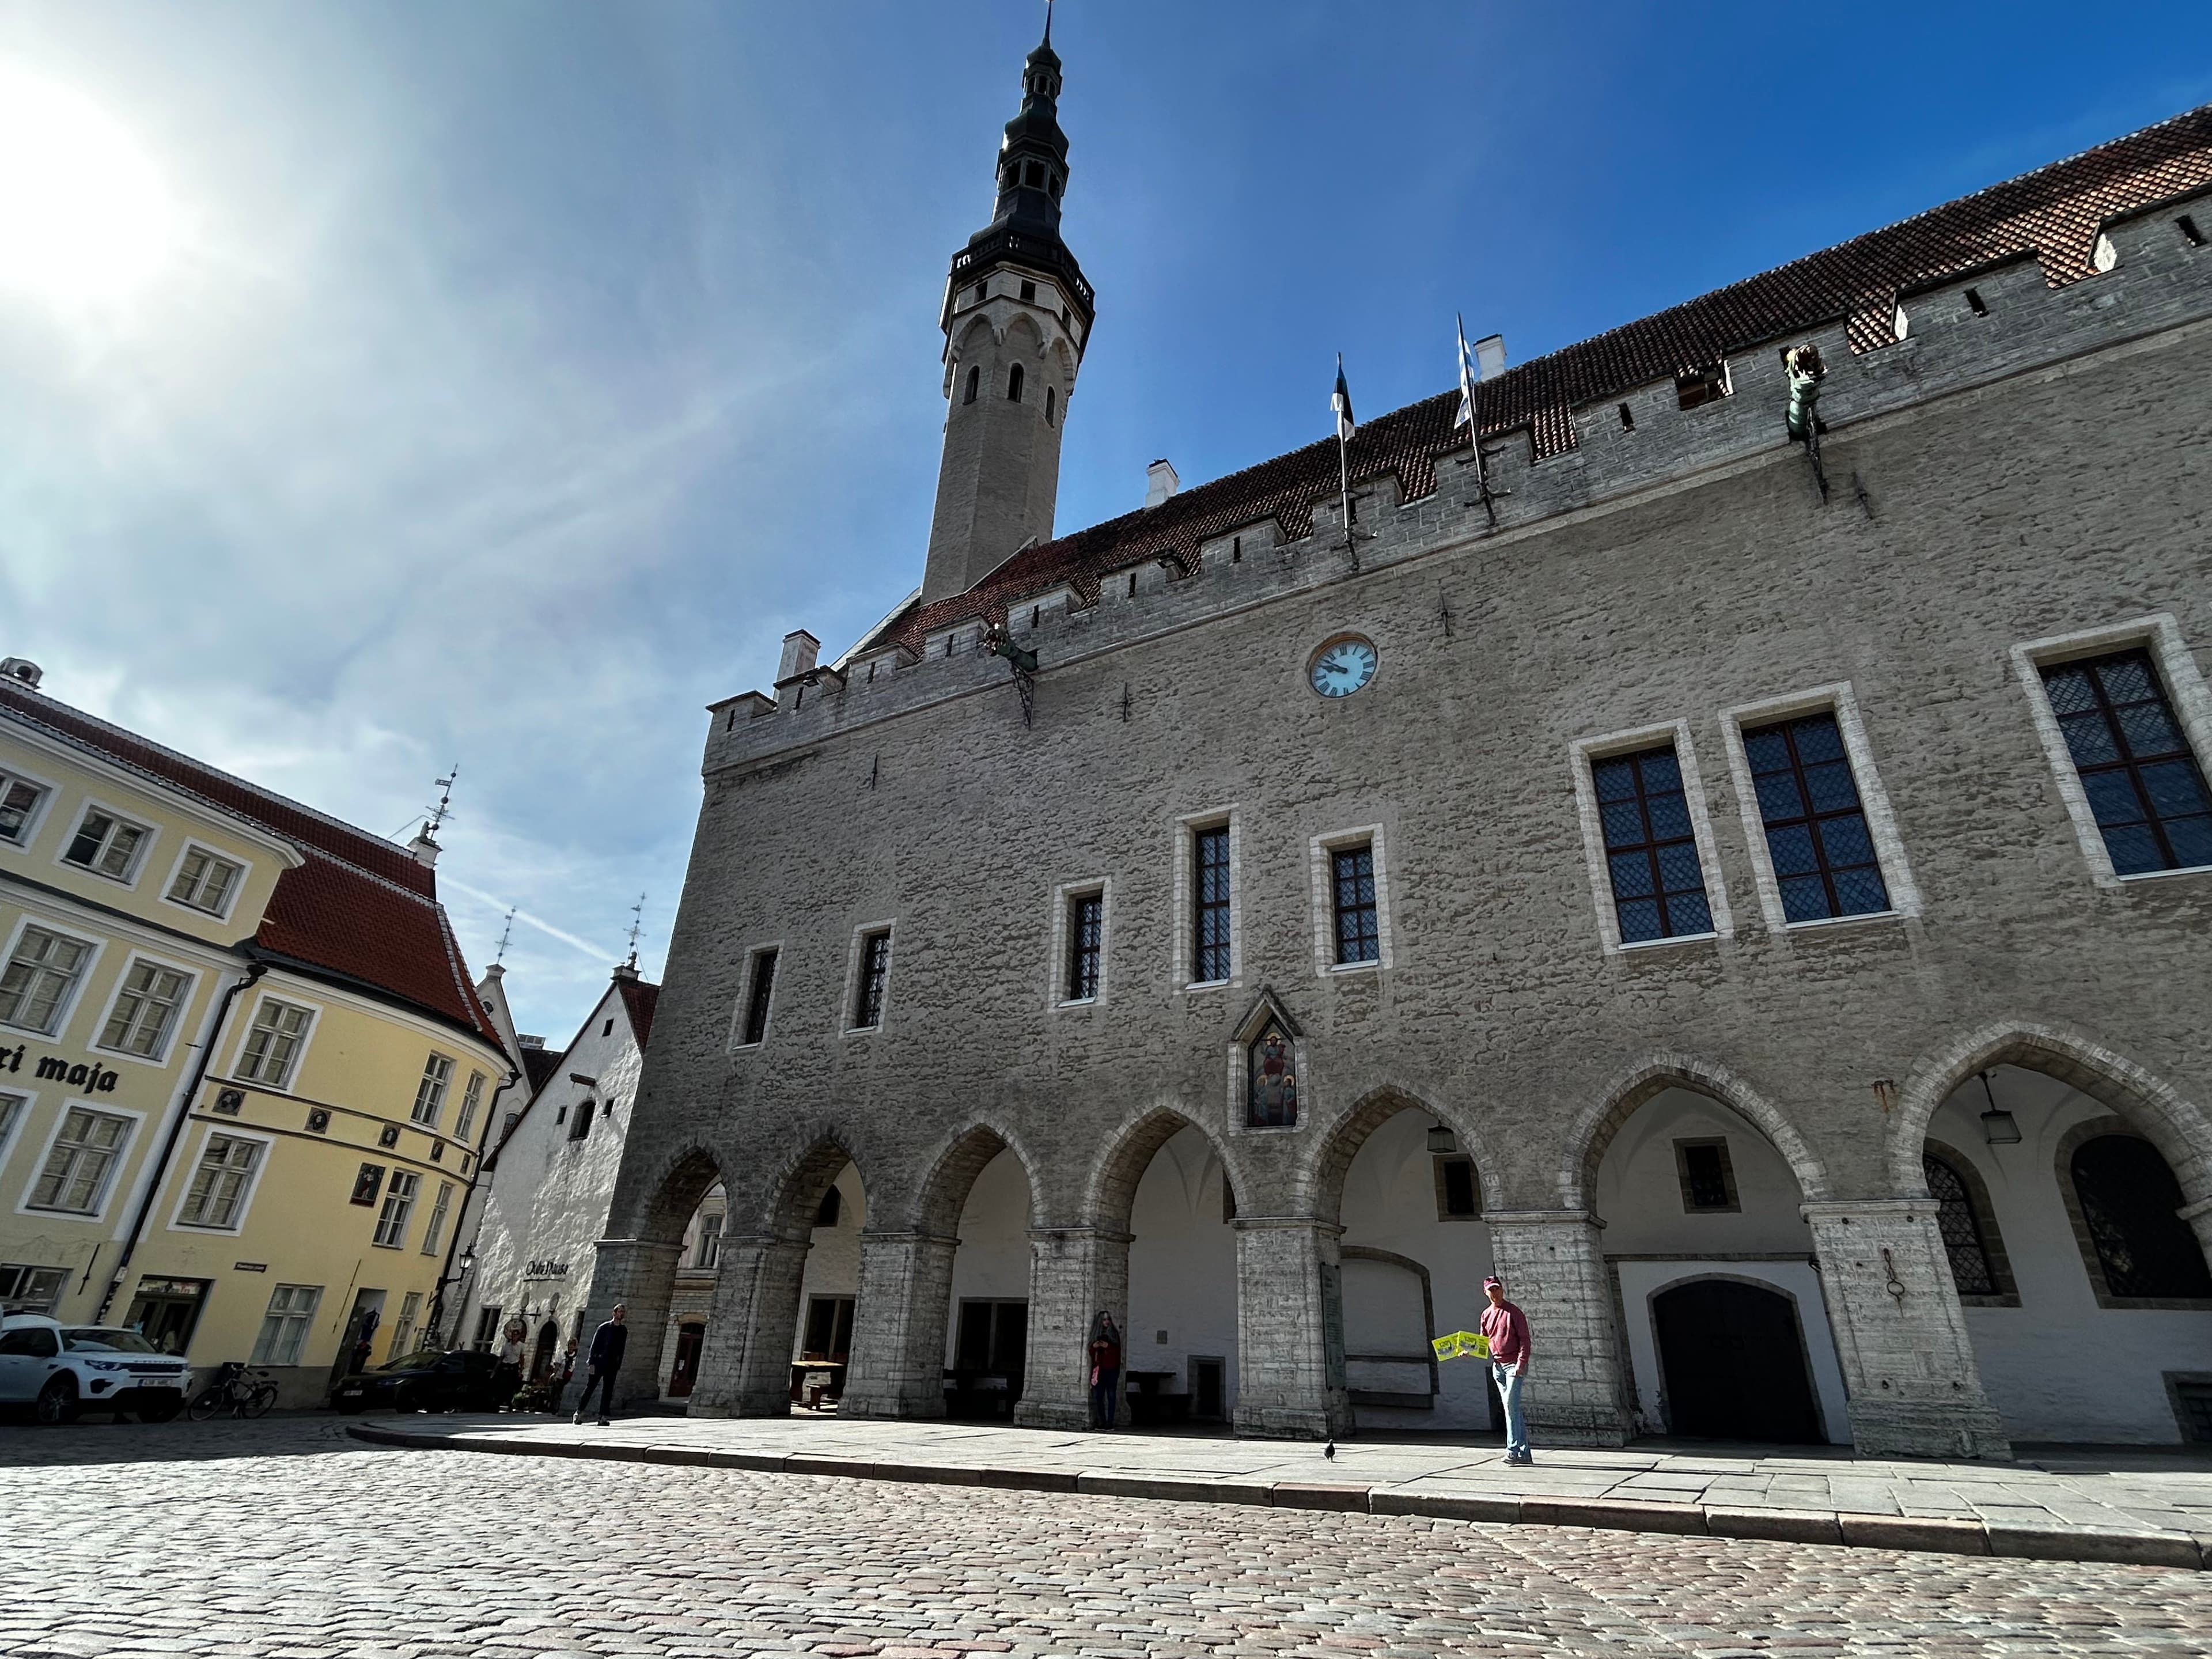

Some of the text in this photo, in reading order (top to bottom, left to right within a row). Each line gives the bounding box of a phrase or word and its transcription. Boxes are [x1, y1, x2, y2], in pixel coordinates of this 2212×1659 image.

[1363, 661, 1374, 669] III
[0, 1044, 119, 1094] ri maja
